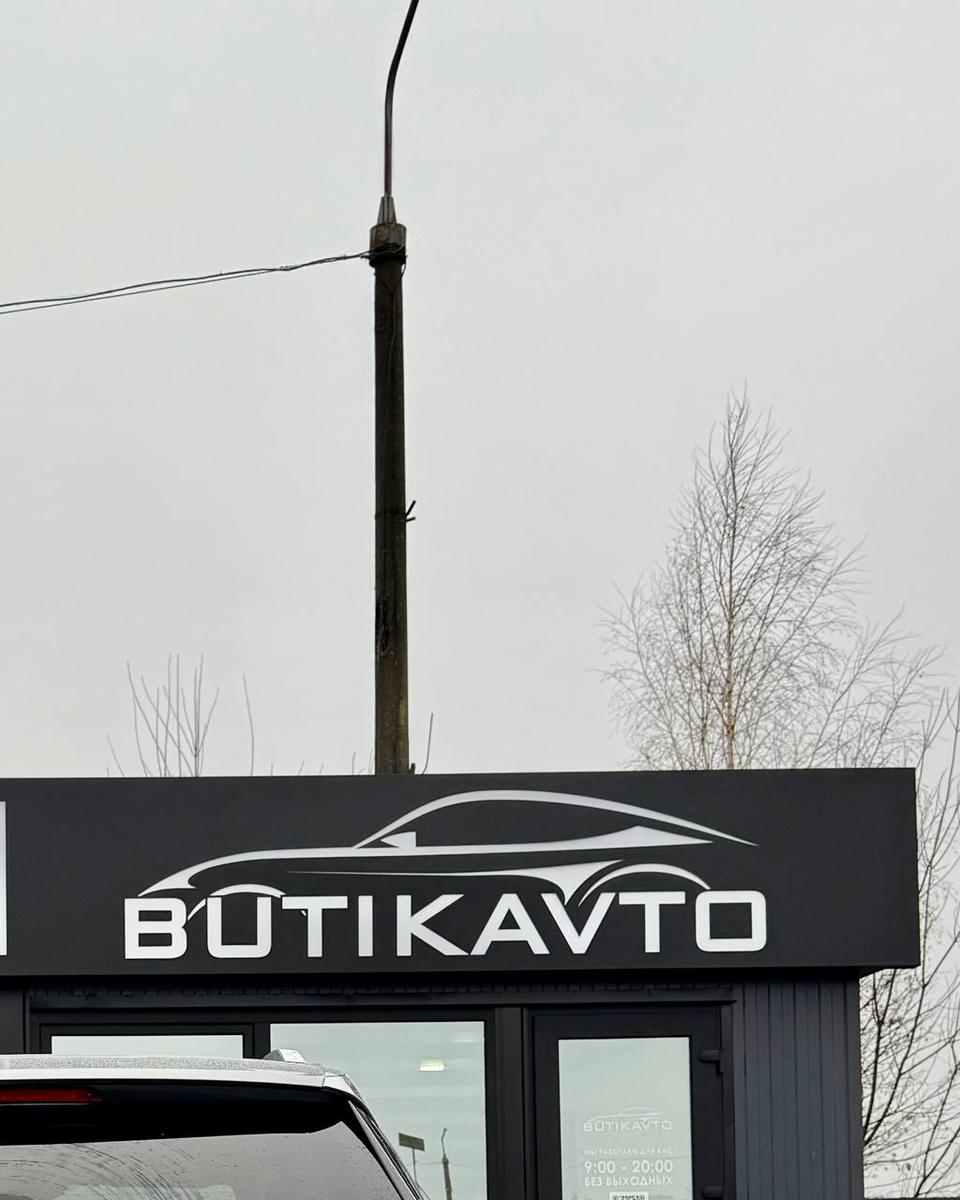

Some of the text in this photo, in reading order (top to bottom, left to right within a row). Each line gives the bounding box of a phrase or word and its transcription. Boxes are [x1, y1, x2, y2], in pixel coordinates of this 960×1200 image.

[124, 890, 767, 960] BUTIKAVTO
[583, 1120, 673, 1132] BUTIKAVTO
[584, 1160, 616, 1174] 9:00
[632, 1159, 673, 1174] 20:00
[584, 1175, 673, 1186] БЕЗ ВЫХОДНЫХ
